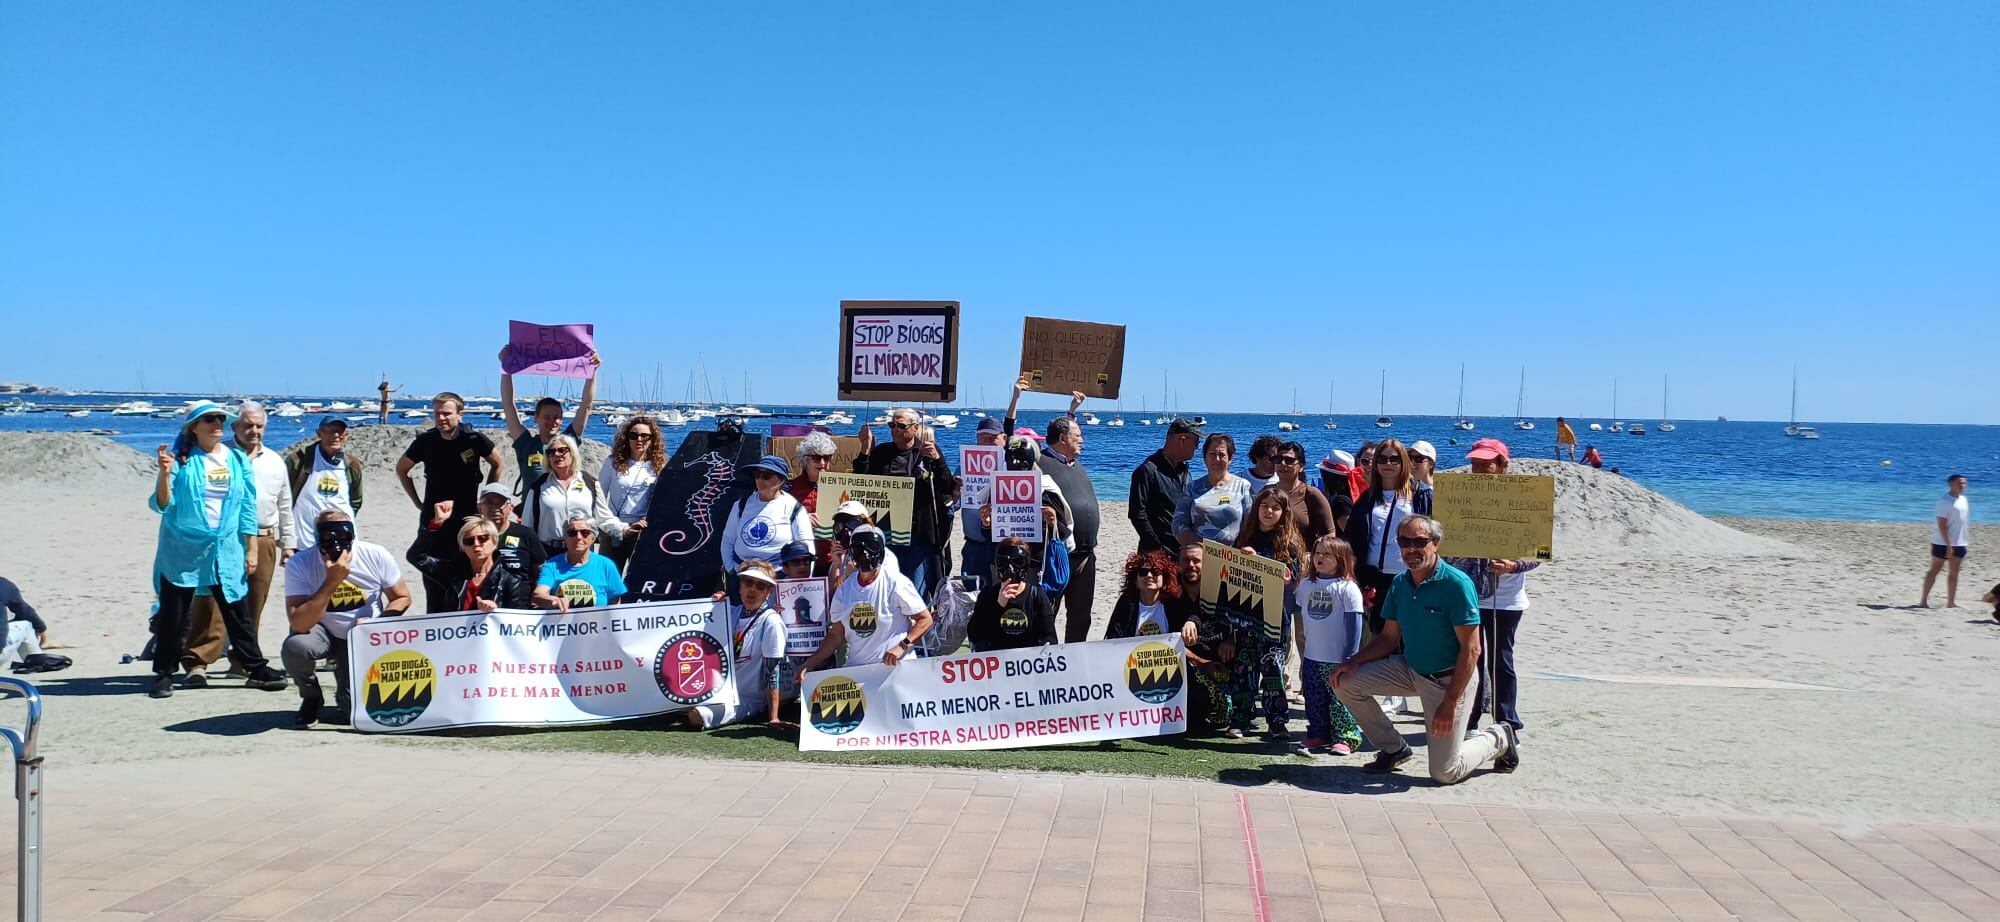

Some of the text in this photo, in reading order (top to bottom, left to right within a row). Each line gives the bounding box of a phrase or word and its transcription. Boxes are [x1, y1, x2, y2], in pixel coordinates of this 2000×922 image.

[539, 328, 562, 344] EL
[855, 325, 893, 344] STOP
[1030, 331, 1049, 343] NO
[511, 342, 590, 358] NEGOCIO
[1042, 348, 1108, 365] EL POZO
[854, 355, 873, 375] EL
[967, 453, 996, 473] NO
[828, 477, 836, 485] EN
[848, 478, 873, 487] PUEBLO
[882, 480, 891, 488] EN
[892, 481, 900, 489] EL
[999, 479, 1033, 501] NO
[850, 490, 865, 498] STOP
[1447, 496, 1472, 506] VIVIR
[1480, 498, 1499, 507] CON
[865, 500, 890, 509] MENOR
[1010, 514, 1035, 522] BIOGÁS
[1447, 509, 1454, 517] Y
[1221, 548, 1233, 561] NO
[1233, 555, 1239, 563] ES
[1240, 558, 1246, 567] DE
[1229, 566, 1242, 578] STOP
[780, 584, 803, 599] STOP
[1228, 575, 1263, 594] MAR MENOR
[370, 629, 419, 646] STOP
[425, 622, 488, 642] BIOGÁS
[500, 623, 536, 637] MAR
[542, 621, 599, 638] MENOR
[611, 619, 632, 632] EL
[637, 612, 714, 631] MIRADOR
[1137, 647, 1174, 660] STOP BIOGÁS
[381, 658, 429, 672] STOP BIOGÁS
[444, 657, 644, 677] POR NUESTRA SALUD Y
[942, 653, 1067, 684] STOP BIOGÁS
[1138, 656, 1179, 669] MAR MENOR
[381, 668, 432, 683] MAR MENOR
[463, 682, 627, 699] LA DEL MAR MENOR
[821, 682, 857, 694] STOP BIOGÁS
[821, 690, 861, 702] MAR MENOR
[901, 700, 937, 719] MAR
[942, 694, 1000, 715] MENOR
[1014, 692, 1034, 708] EL
[1039, 683, 1114, 706] MIRADOR
[837, 737, 870, 747] POR
[957, 723, 1010, 744] SALUD
[1015, 714, 1100, 738] PRESENTE
[1104, 712, 1114, 729] Y
[1119, 706, 1184, 727] FUTURA
